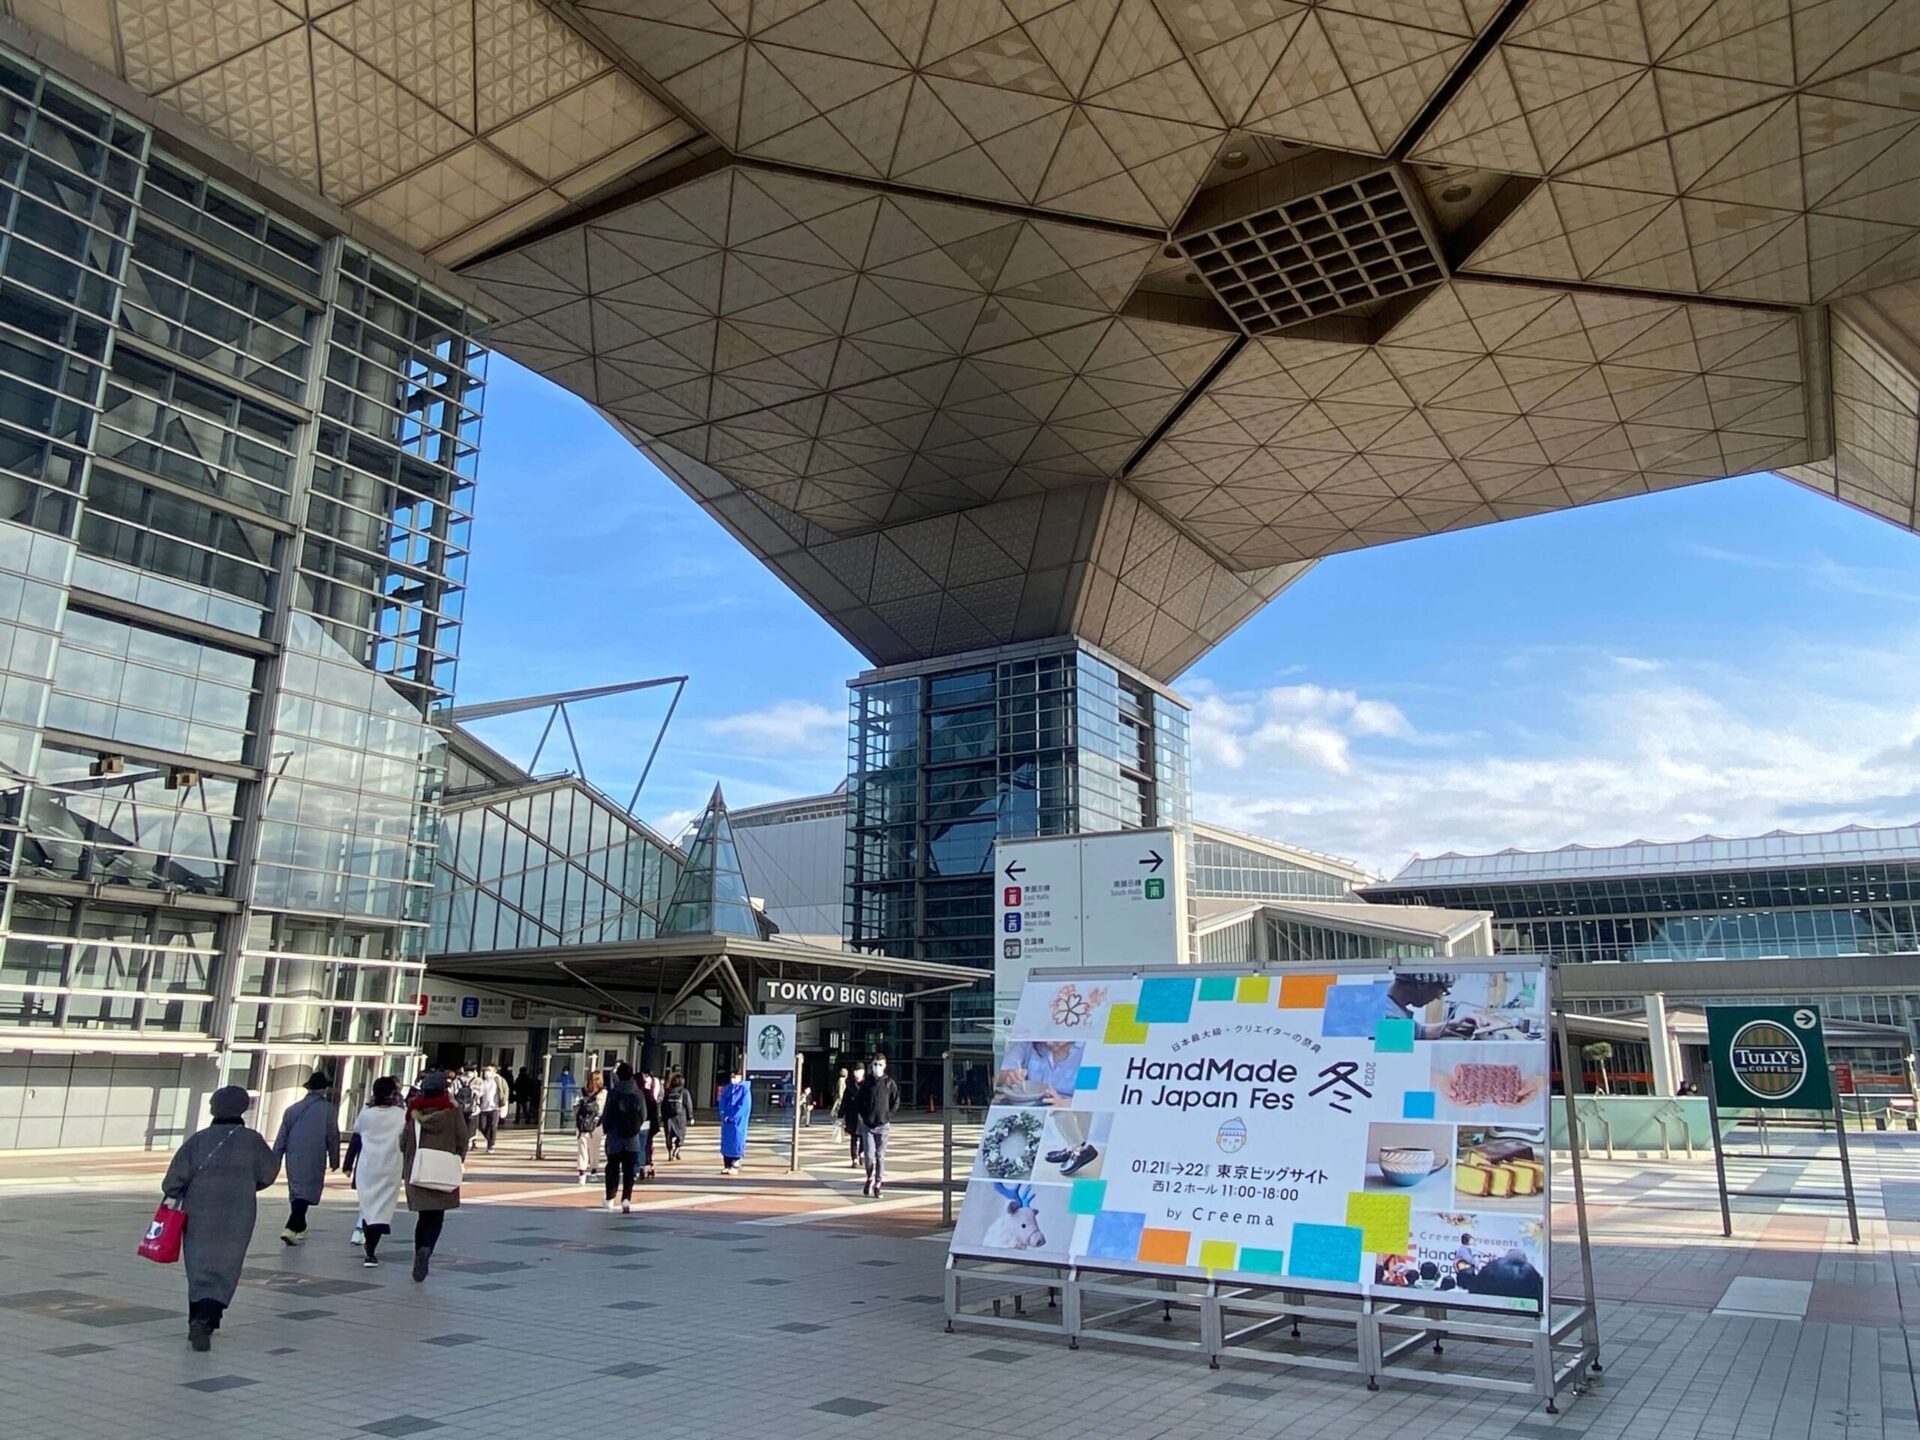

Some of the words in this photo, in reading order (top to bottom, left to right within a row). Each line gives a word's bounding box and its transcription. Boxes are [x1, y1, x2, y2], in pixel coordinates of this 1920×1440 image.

[767, 981, 835, 1002] TOKYO
[840, 987, 866, 1004] BIG
[870, 990, 904, 1008] SIGHT
[1125, 1057, 1298, 1083] HandMade
[1364, 1062, 1377, 1087] 2023
[1120, 1084, 1143, 1105] In
[1151, 1085, 1238, 1112] Japan
[1249, 1088, 1296, 1111] Fes
[1308, 1061, 1373, 1114] 冬
[1216, 1164, 1329, 1184] 東京ビッグサイト
[1222, 1184, 1299, 1202] 11:00-18:00
[1166, 1207, 1182, 1220] by
[1192, 1207, 1274, 1226] Creema
